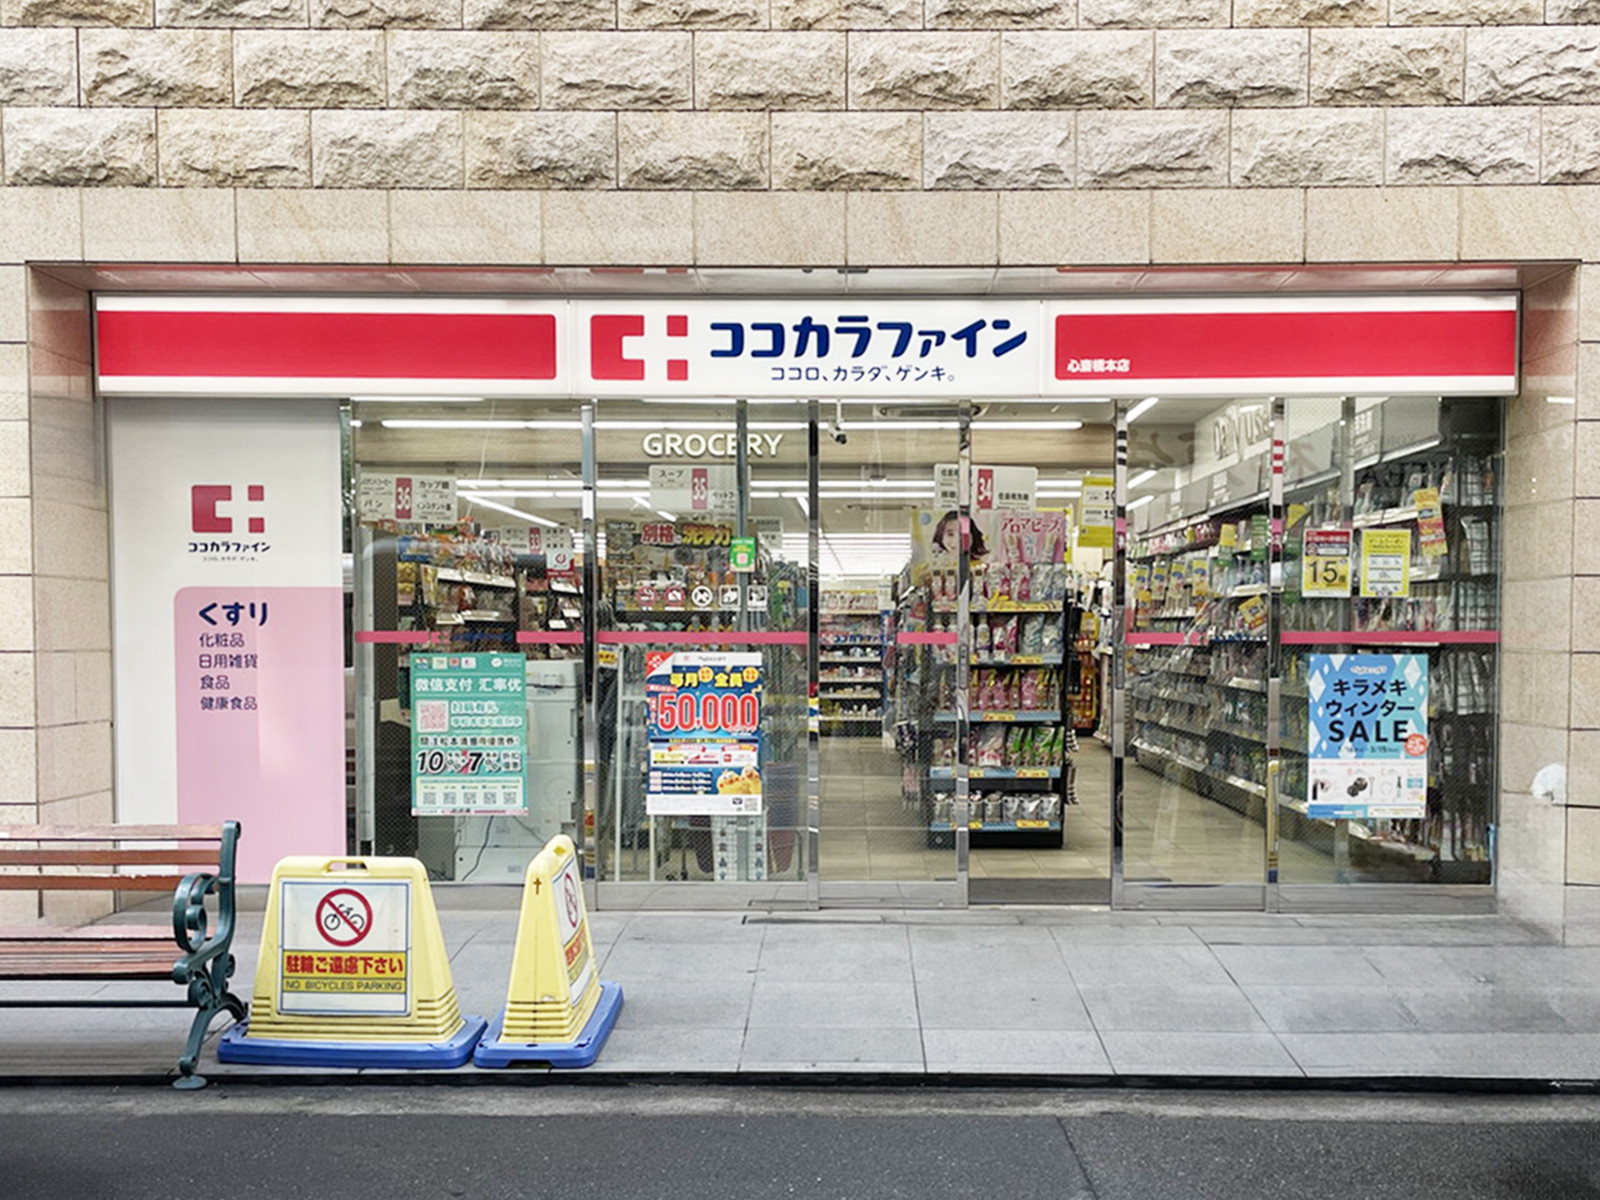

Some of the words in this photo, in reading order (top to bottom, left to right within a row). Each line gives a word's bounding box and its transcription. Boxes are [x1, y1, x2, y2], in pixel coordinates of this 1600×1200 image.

[710, 316, 1028, 358] ココカラファイン
[771, 365, 955, 382] ココロ、カラダ、ゲンキ。
[642, 433, 783, 457] GROCERY
[692, 477, 707, 501] 35
[978, 478, 992, 501] 34
[397, 487, 411, 510] 36
[187, 541, 271, 552] ココカラファイン
[198, 602, 268, 626] くすり
[199, 632, 245, 648] 化粧品
[199, 653, 259, 669] 日用雑貨
[200, 674, 230, 690] 食品
[415, 678, 473, 692] 微信支付
[479, 678, 522, 692] 汇率优
[1333, 679, 1407, 696] キラメキ
[200, 696, 258, 711] 健康食品
[1325, 699, 1415, 717] ウィンター
[1329, 720, 1408, 742] SALE
[286, 955, 404, 974] 駐輪ご遠慮下さい
[286, 981, 300, 990] NO
[305, 981, 354, 990] BICYCLES
[356, 981, 403, 991] PARKING
